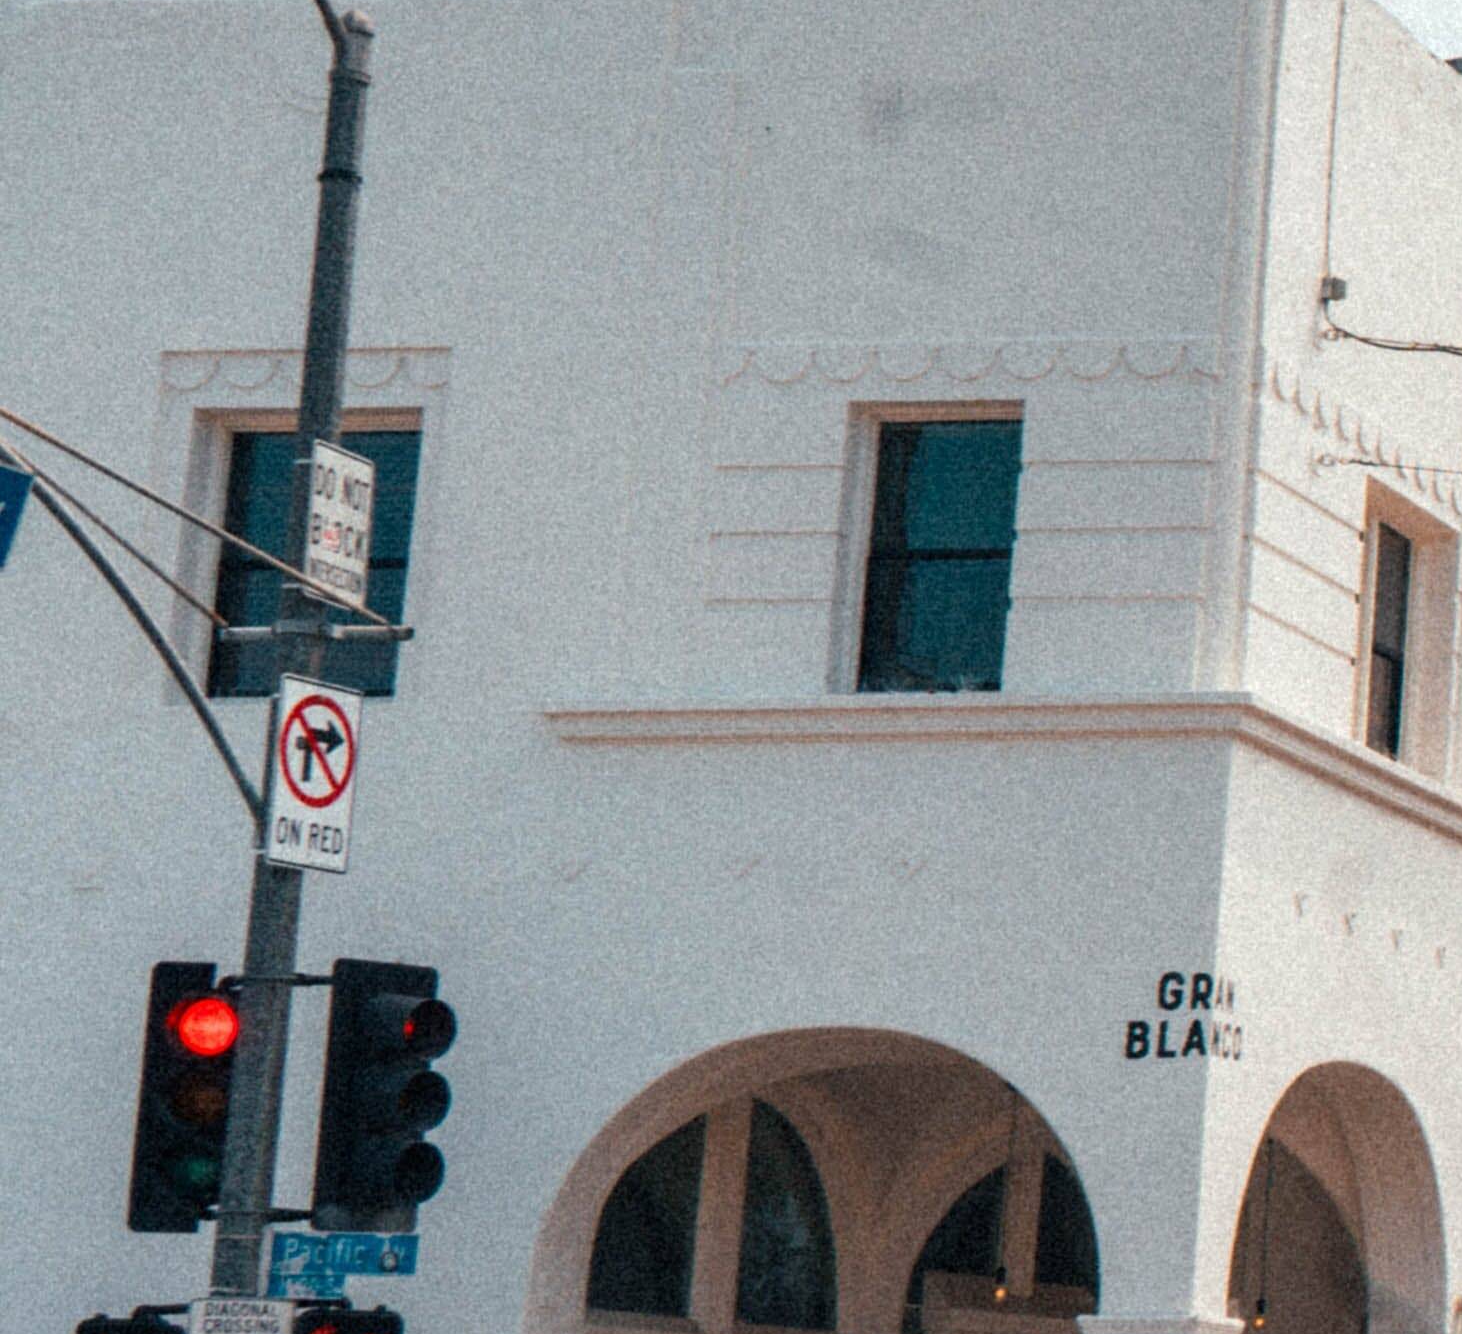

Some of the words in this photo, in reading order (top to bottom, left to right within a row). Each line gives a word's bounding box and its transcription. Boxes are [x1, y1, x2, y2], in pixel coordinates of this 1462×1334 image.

[315, 464, 336, 501] DO
[341, 474, 371, 511] NOT
[311, 512, 367, 560] BOCK
[275, 816, 304, 847] ON
[308, 822, 343, 854] RED
[1157, 970, 1234, 1012] GRAN
[1125, 1019, 1242, 1062] BLANCO
[284, 1238, 367, 1265] Pacific
[202, 1319, 282, 1334] CROSSING
[204, 1302, 276, 1318] DIAGONAL
